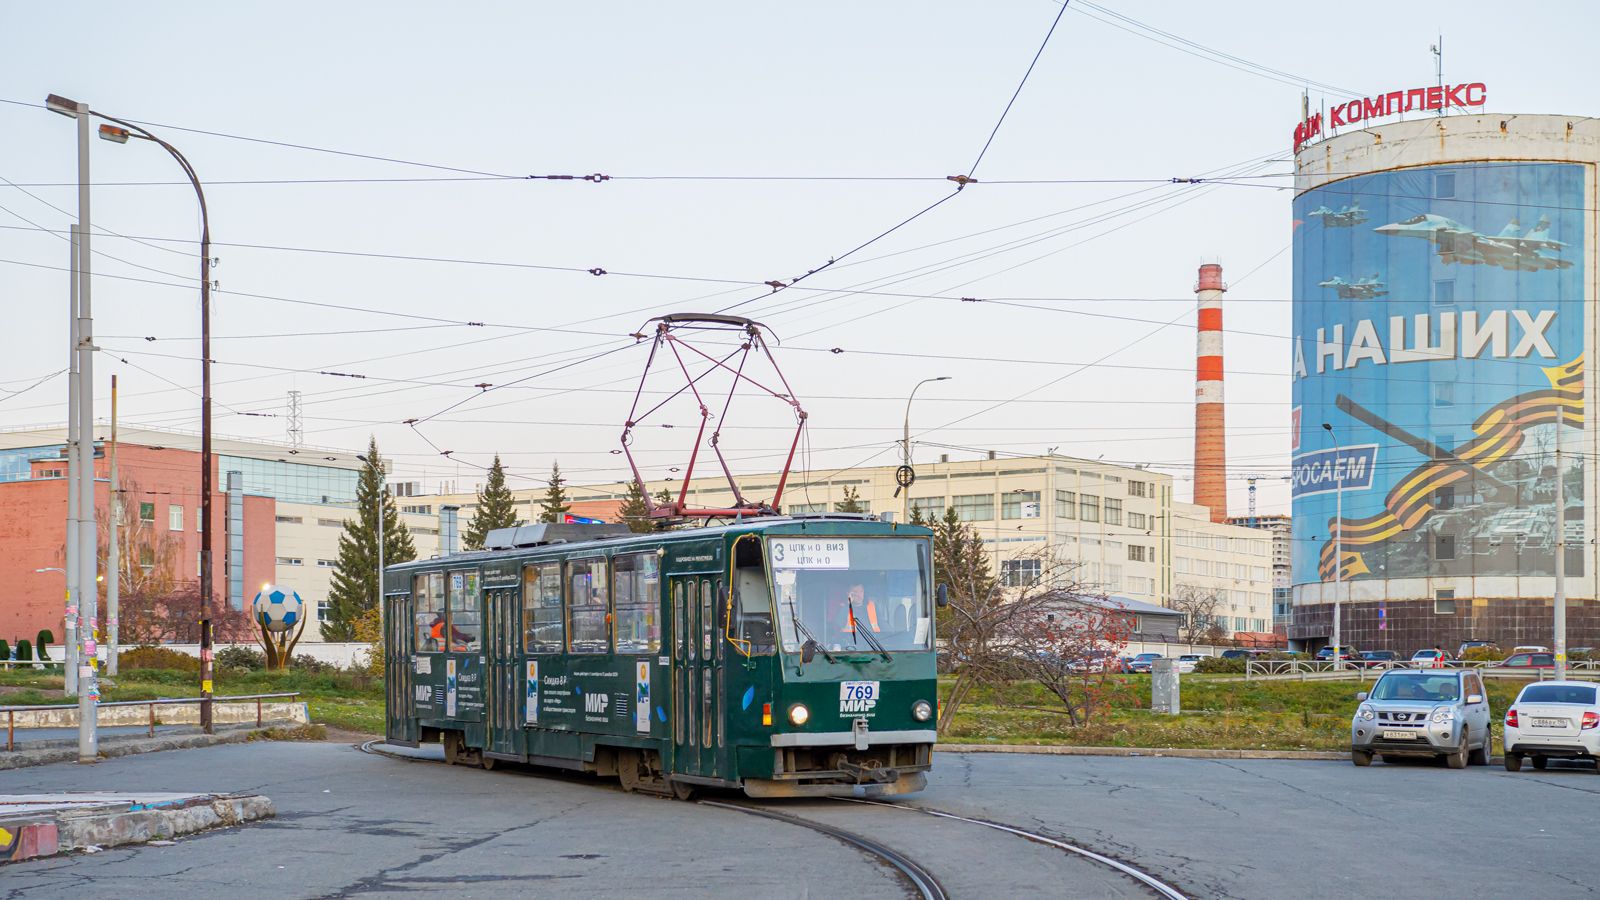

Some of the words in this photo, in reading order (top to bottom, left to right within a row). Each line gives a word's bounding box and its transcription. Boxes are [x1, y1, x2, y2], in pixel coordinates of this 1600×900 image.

[1331, 82, 1486, 129] КОМПЛЕКС
[1316, 310, 1558, 375] НАШИХ
[775, 543, 784, 562] 3
[789, 543, 805, 552] ЦПК
[826, 543, 844, 551] ВИЗ
[797, 557, 813, 565] ЦПК
[415, 685, 432, 701] МИР
[847, 685, 873, 699] 769
[585, 693, 608, 713] МИР
[840, 700, 876, 712] МИР
